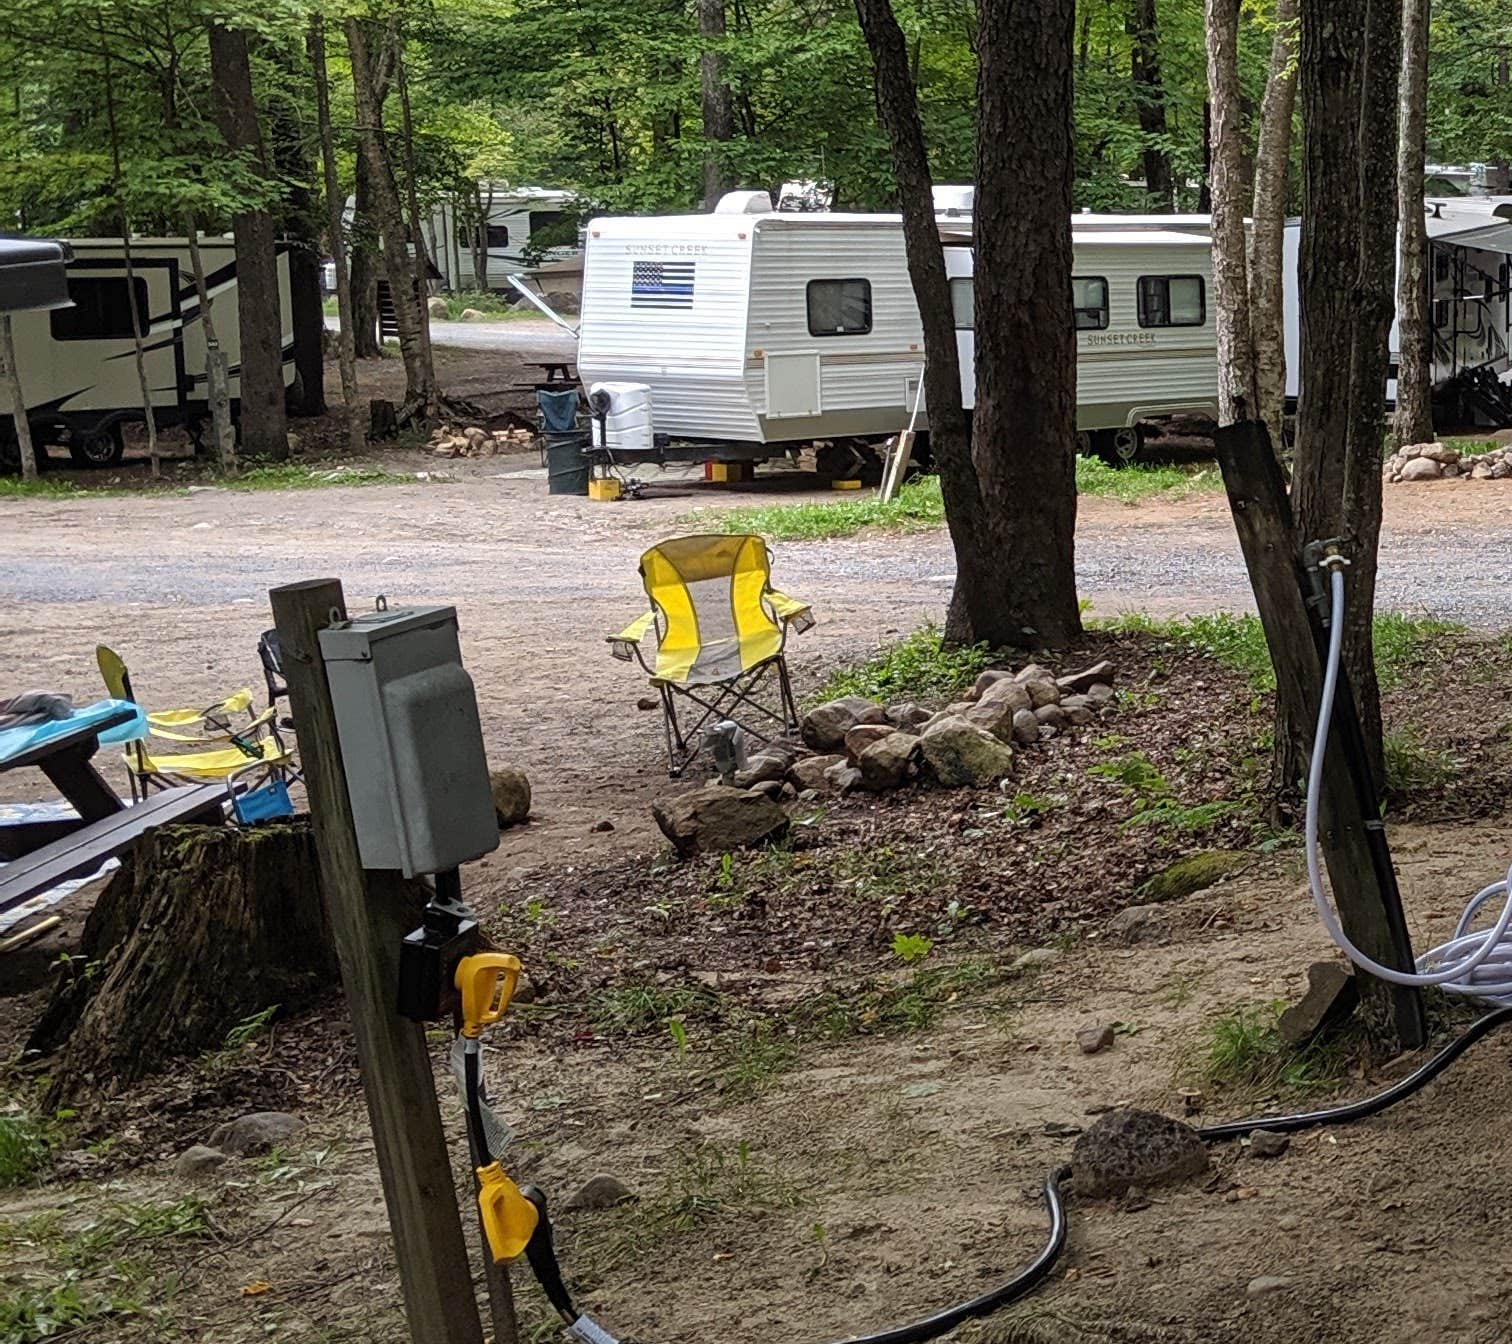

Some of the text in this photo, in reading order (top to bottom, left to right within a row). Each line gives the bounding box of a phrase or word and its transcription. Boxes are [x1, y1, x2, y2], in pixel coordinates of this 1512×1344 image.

[624, 244, 708, 256] SUNSET CREEK
[1087, 333, 1156, 346] SUNSET CREEK
